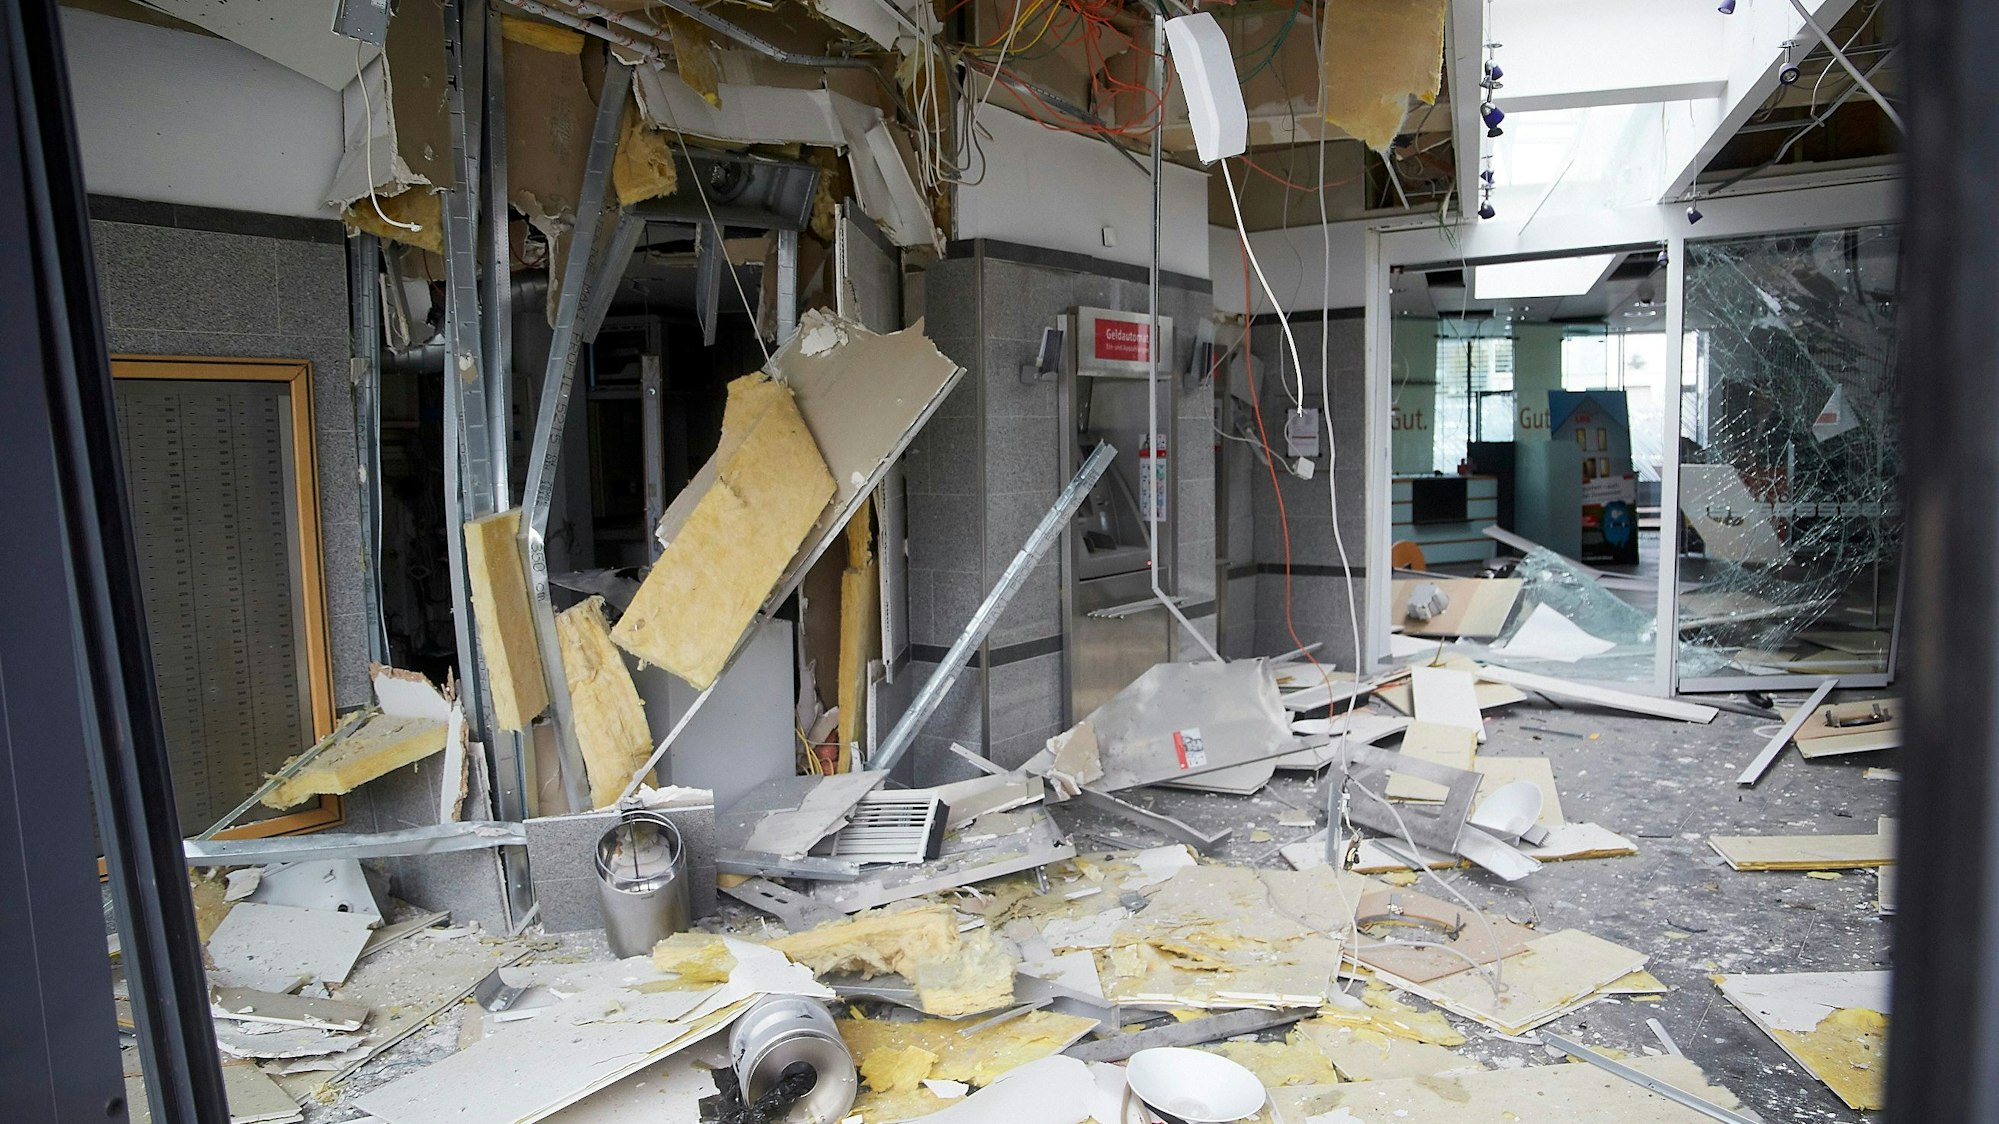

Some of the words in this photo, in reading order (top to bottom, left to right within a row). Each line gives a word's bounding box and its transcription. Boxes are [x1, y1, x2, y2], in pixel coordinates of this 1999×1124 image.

[575, 282, 592, 321] MAXI
[560, 331, 580, 392] PROFIL
[549, 403, 567, 444] 5215
[531, 542, 546, 572] 350
[1010, 549, 1044, 590] PROFIL
[535, 582, 546, 602] cm
